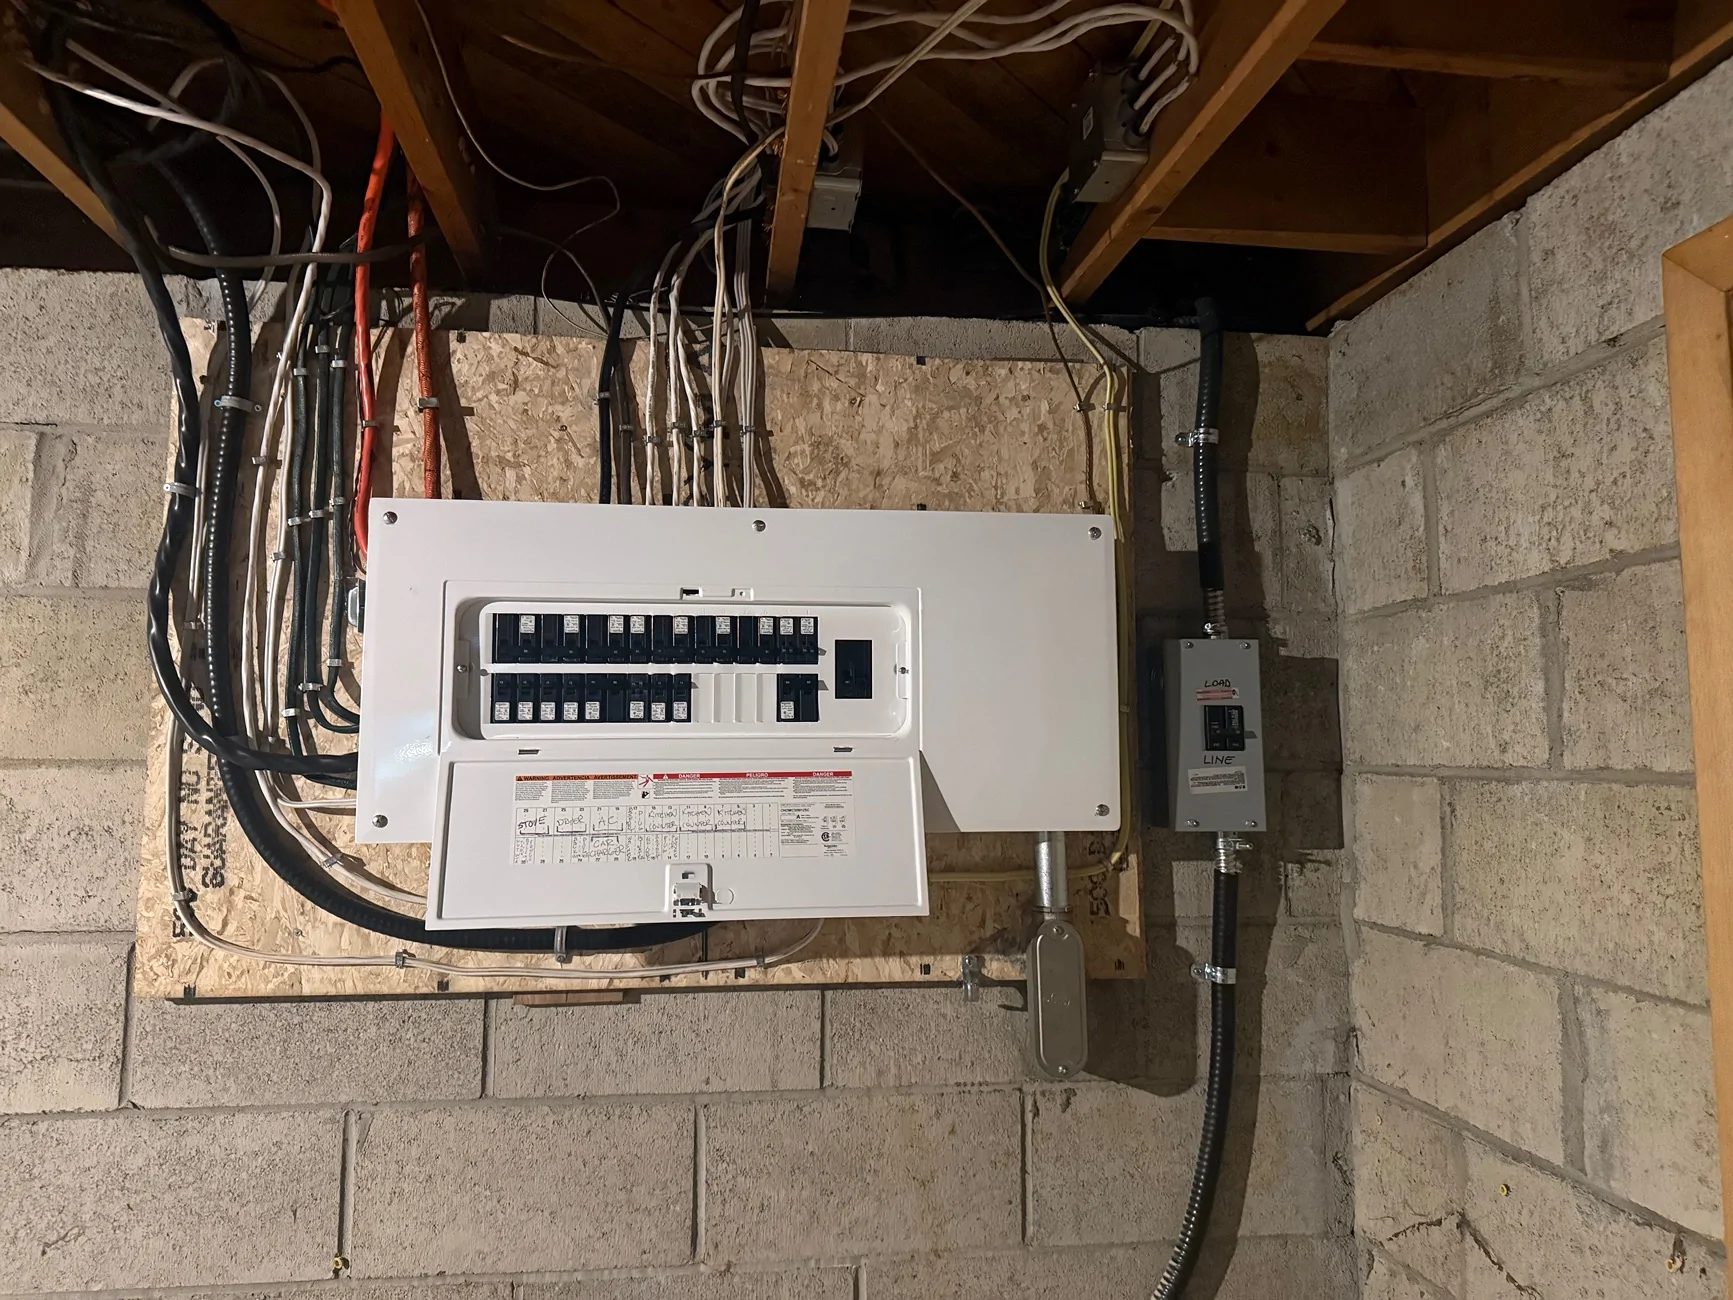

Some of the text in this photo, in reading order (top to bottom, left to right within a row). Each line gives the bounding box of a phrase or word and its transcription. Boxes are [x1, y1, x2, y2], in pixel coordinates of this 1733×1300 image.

[1204, 679, 1231, 688] LOAD
[1203, 755, 1236, 765] LINE
[518, 815, 547, 829] STOVE
[593, 839, 615, 849] CAR
